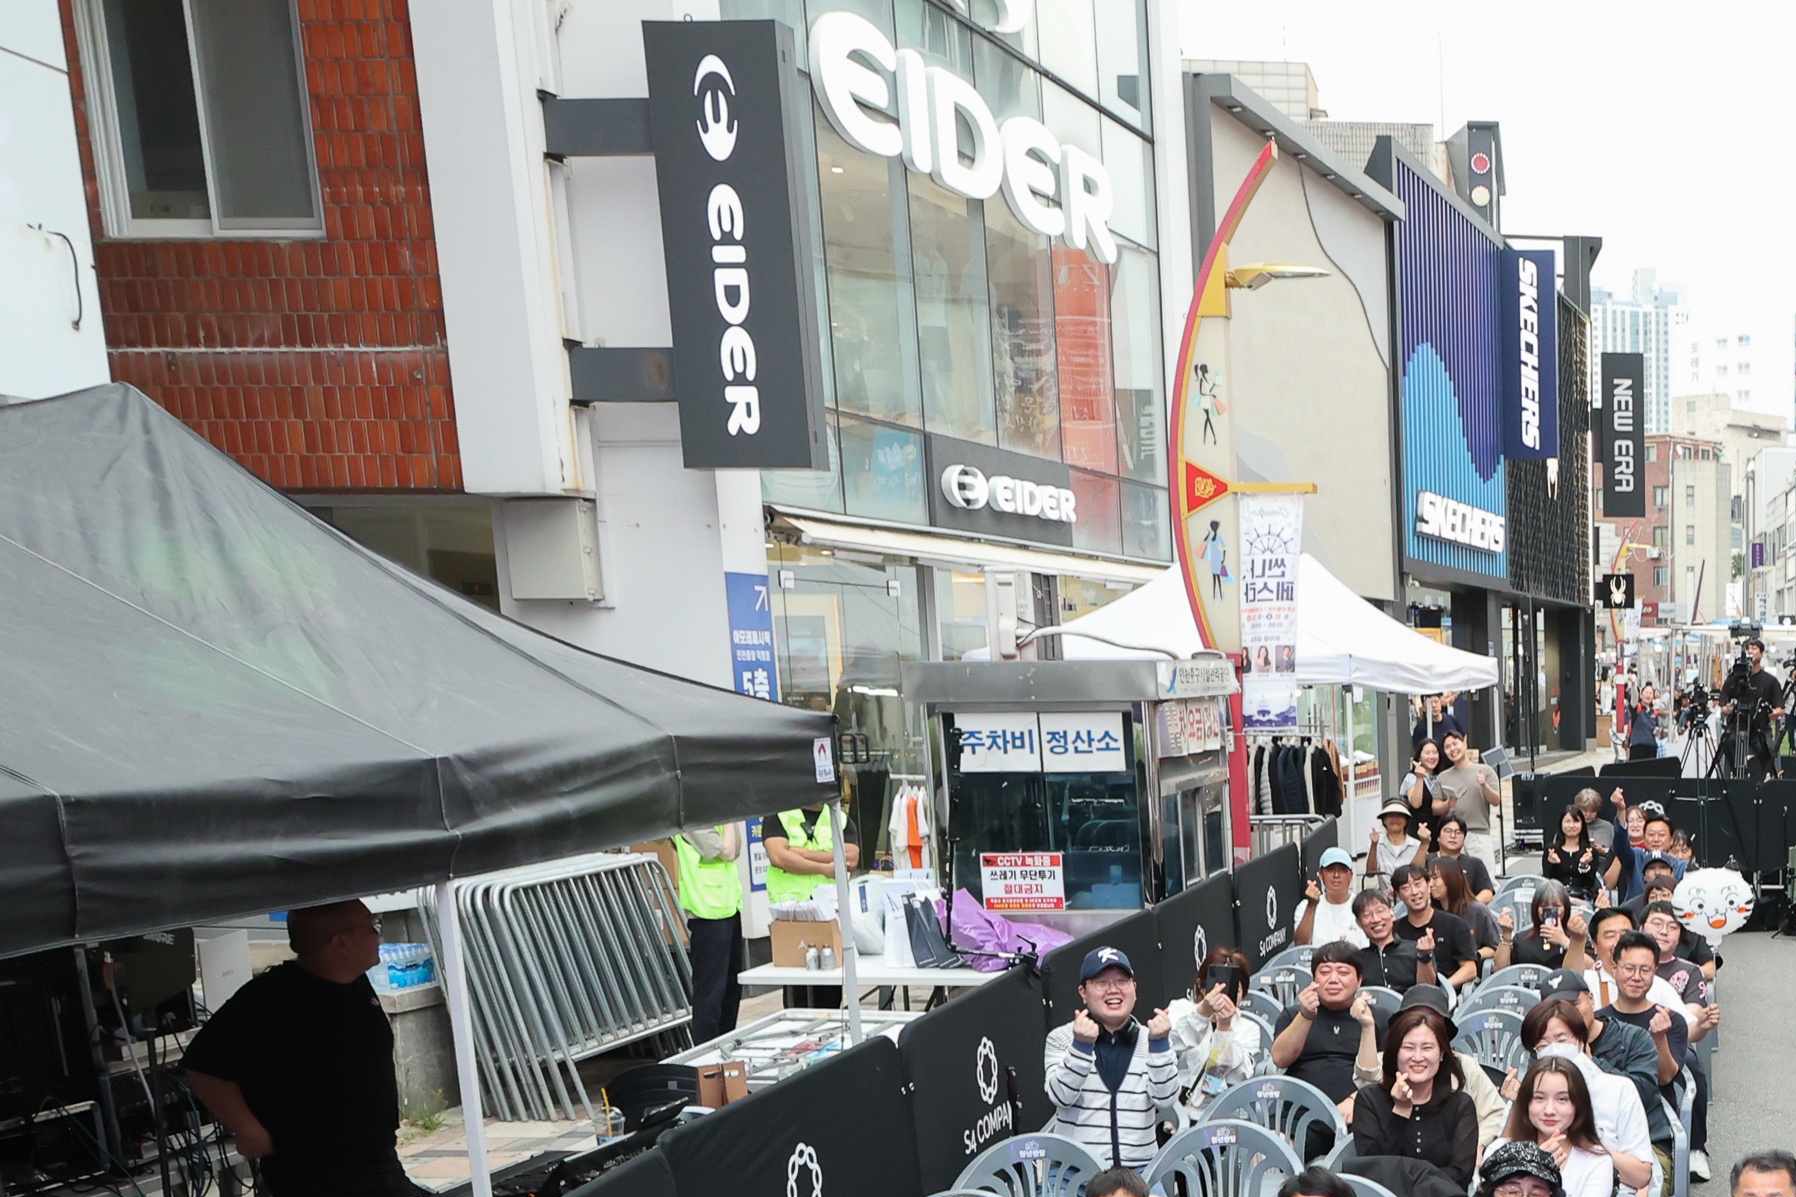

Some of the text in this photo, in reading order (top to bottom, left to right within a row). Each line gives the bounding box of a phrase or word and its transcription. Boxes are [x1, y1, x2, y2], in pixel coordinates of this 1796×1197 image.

[809, 10, 1118, 264] EIDER
[707, 183, 760, 437] EIDER
[1518, 257, 1541, 450] SKECHERS
[1612, 378, 1635, 493] NEW ERA
[993, 474, 1077, 523] EIDER
[1416, 491, 1506, 553] SKECHERS
[742, 667, 770, 700] 5층
[961, 729, 1121, 754] 주차비 정산소
[990, 870, 1056, 880] 쓰레기 무단투기
[997, 856, 1022, 866] CCTV
[1004, 884, 1043, 894] 절대금지
[1260, 927, 1286, 957] S4 COMPANY
[964, 1129, 977, 1155] S4
